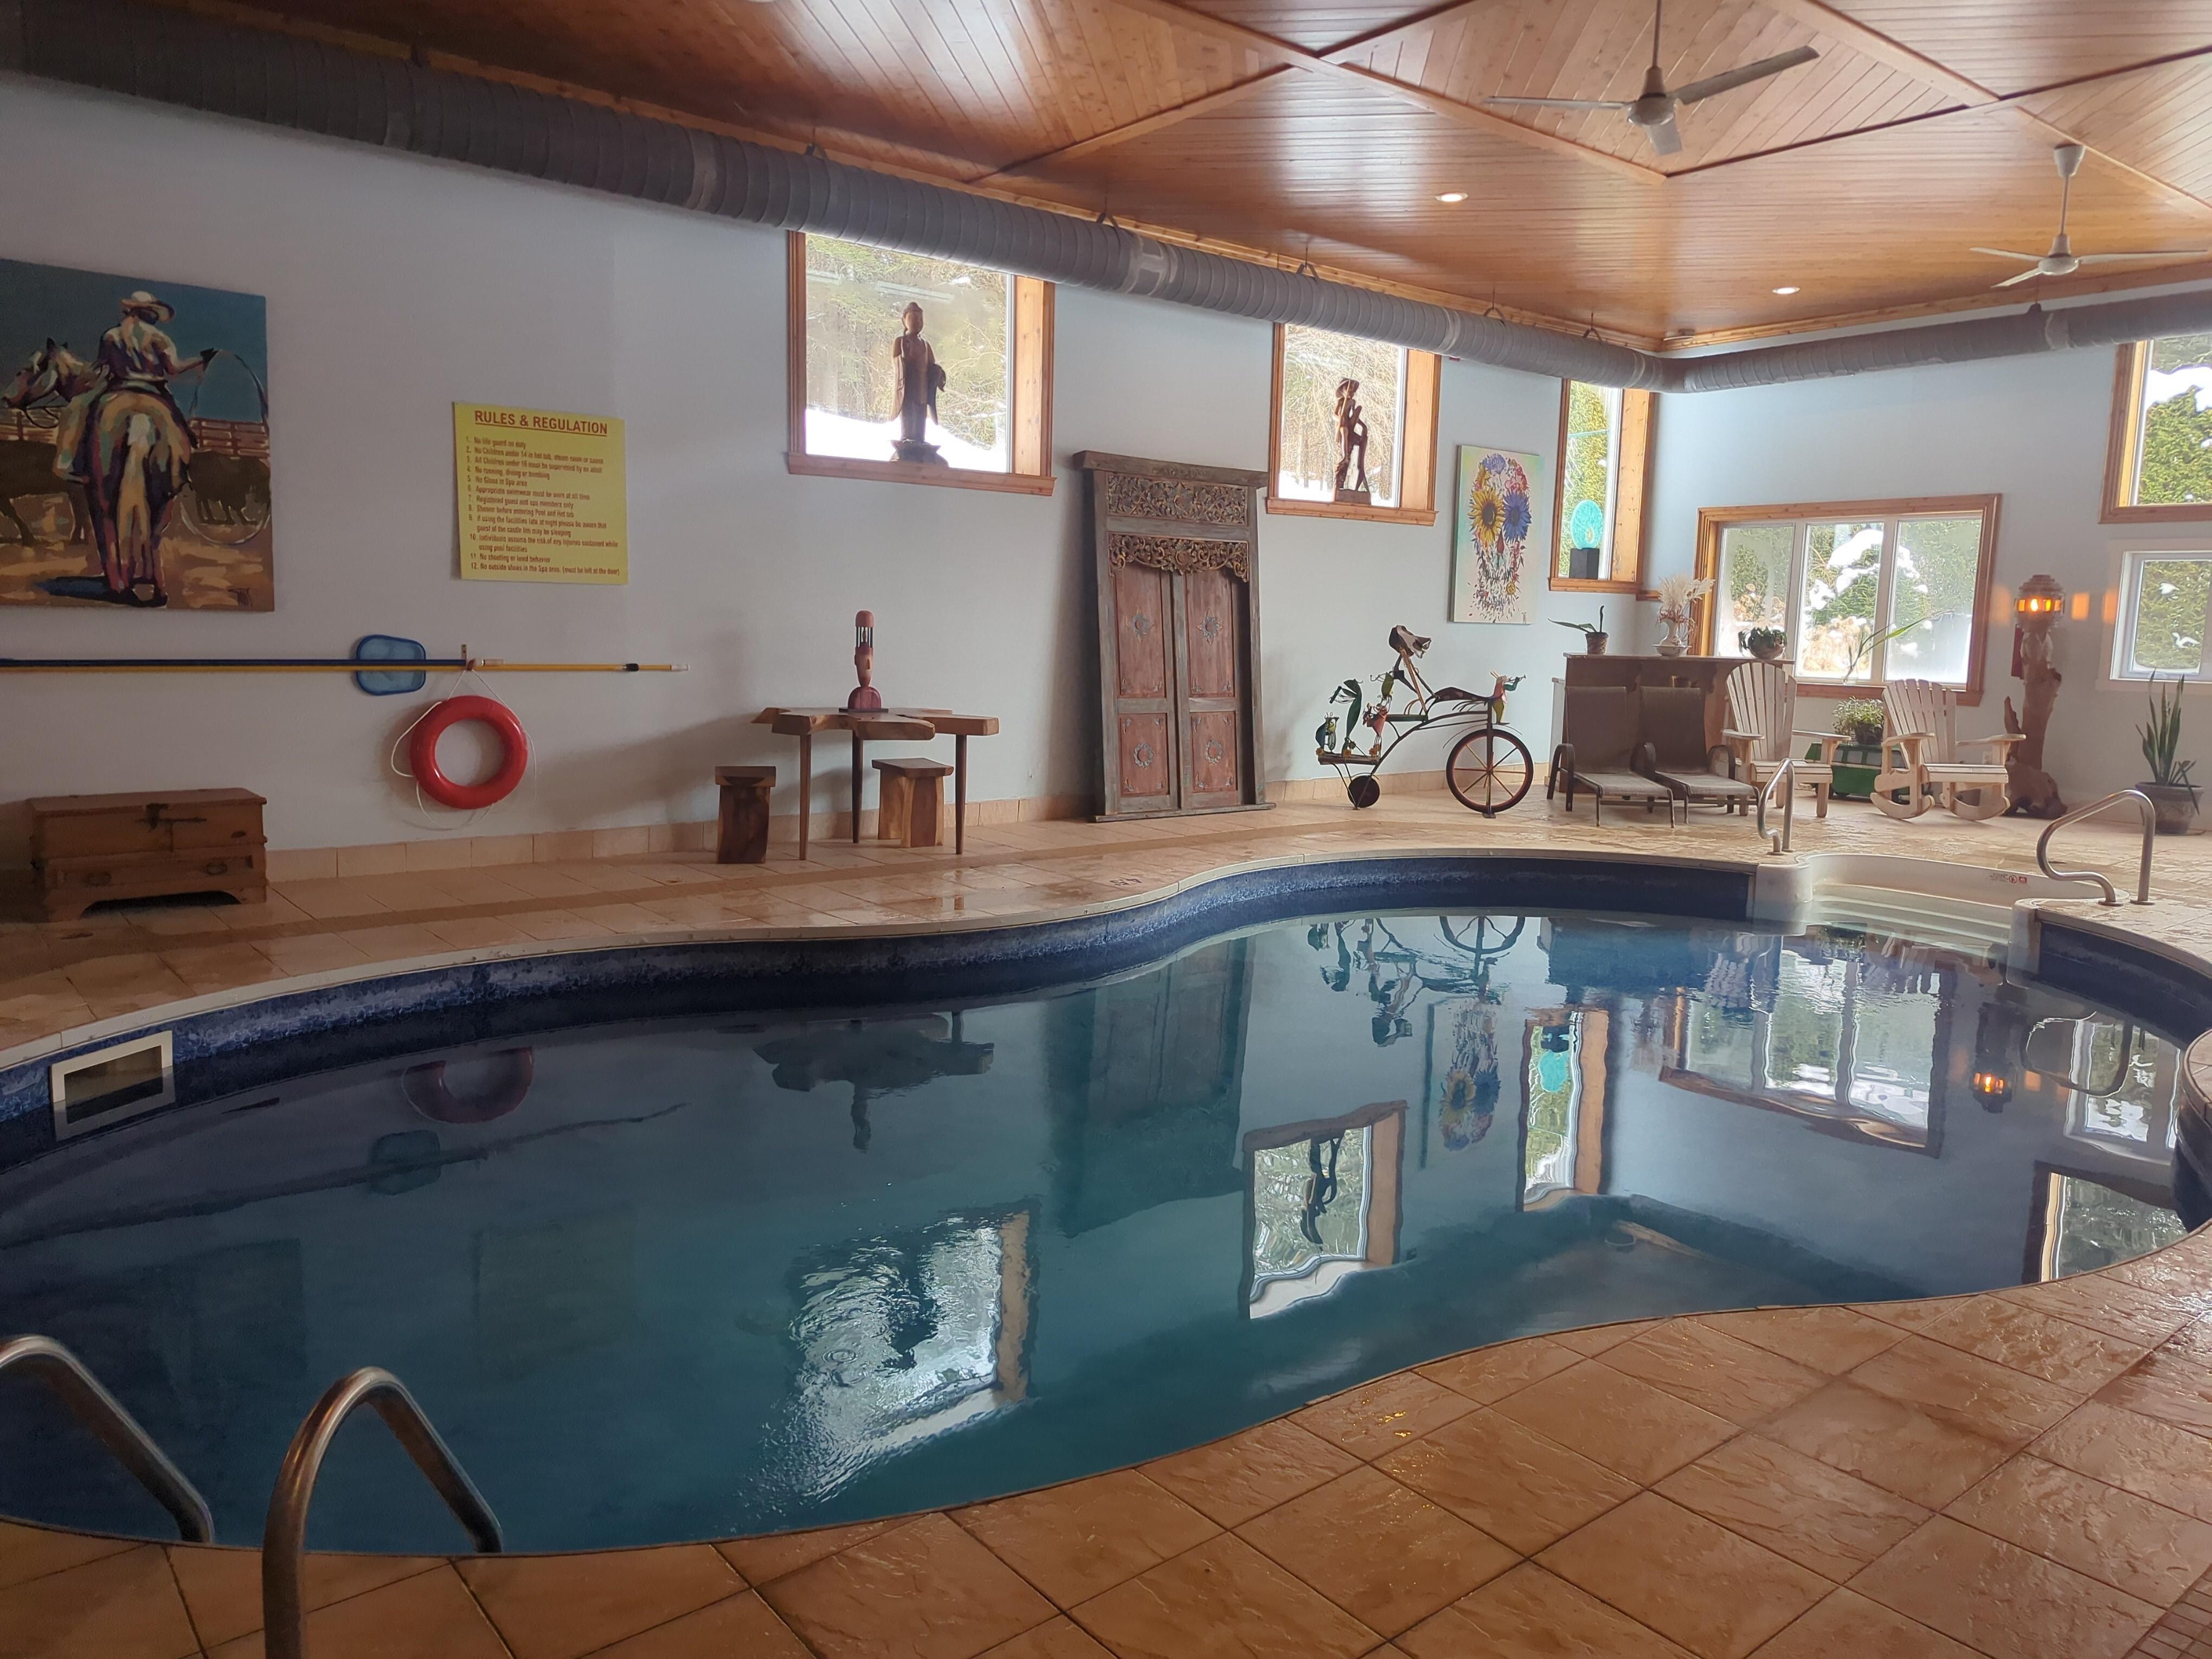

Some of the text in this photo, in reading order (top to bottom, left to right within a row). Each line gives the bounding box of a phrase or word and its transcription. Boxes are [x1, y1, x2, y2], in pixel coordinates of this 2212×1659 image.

[474, 410, 607, 434] RULES & REGULATION
[538, 565, 548, 573] Spa
